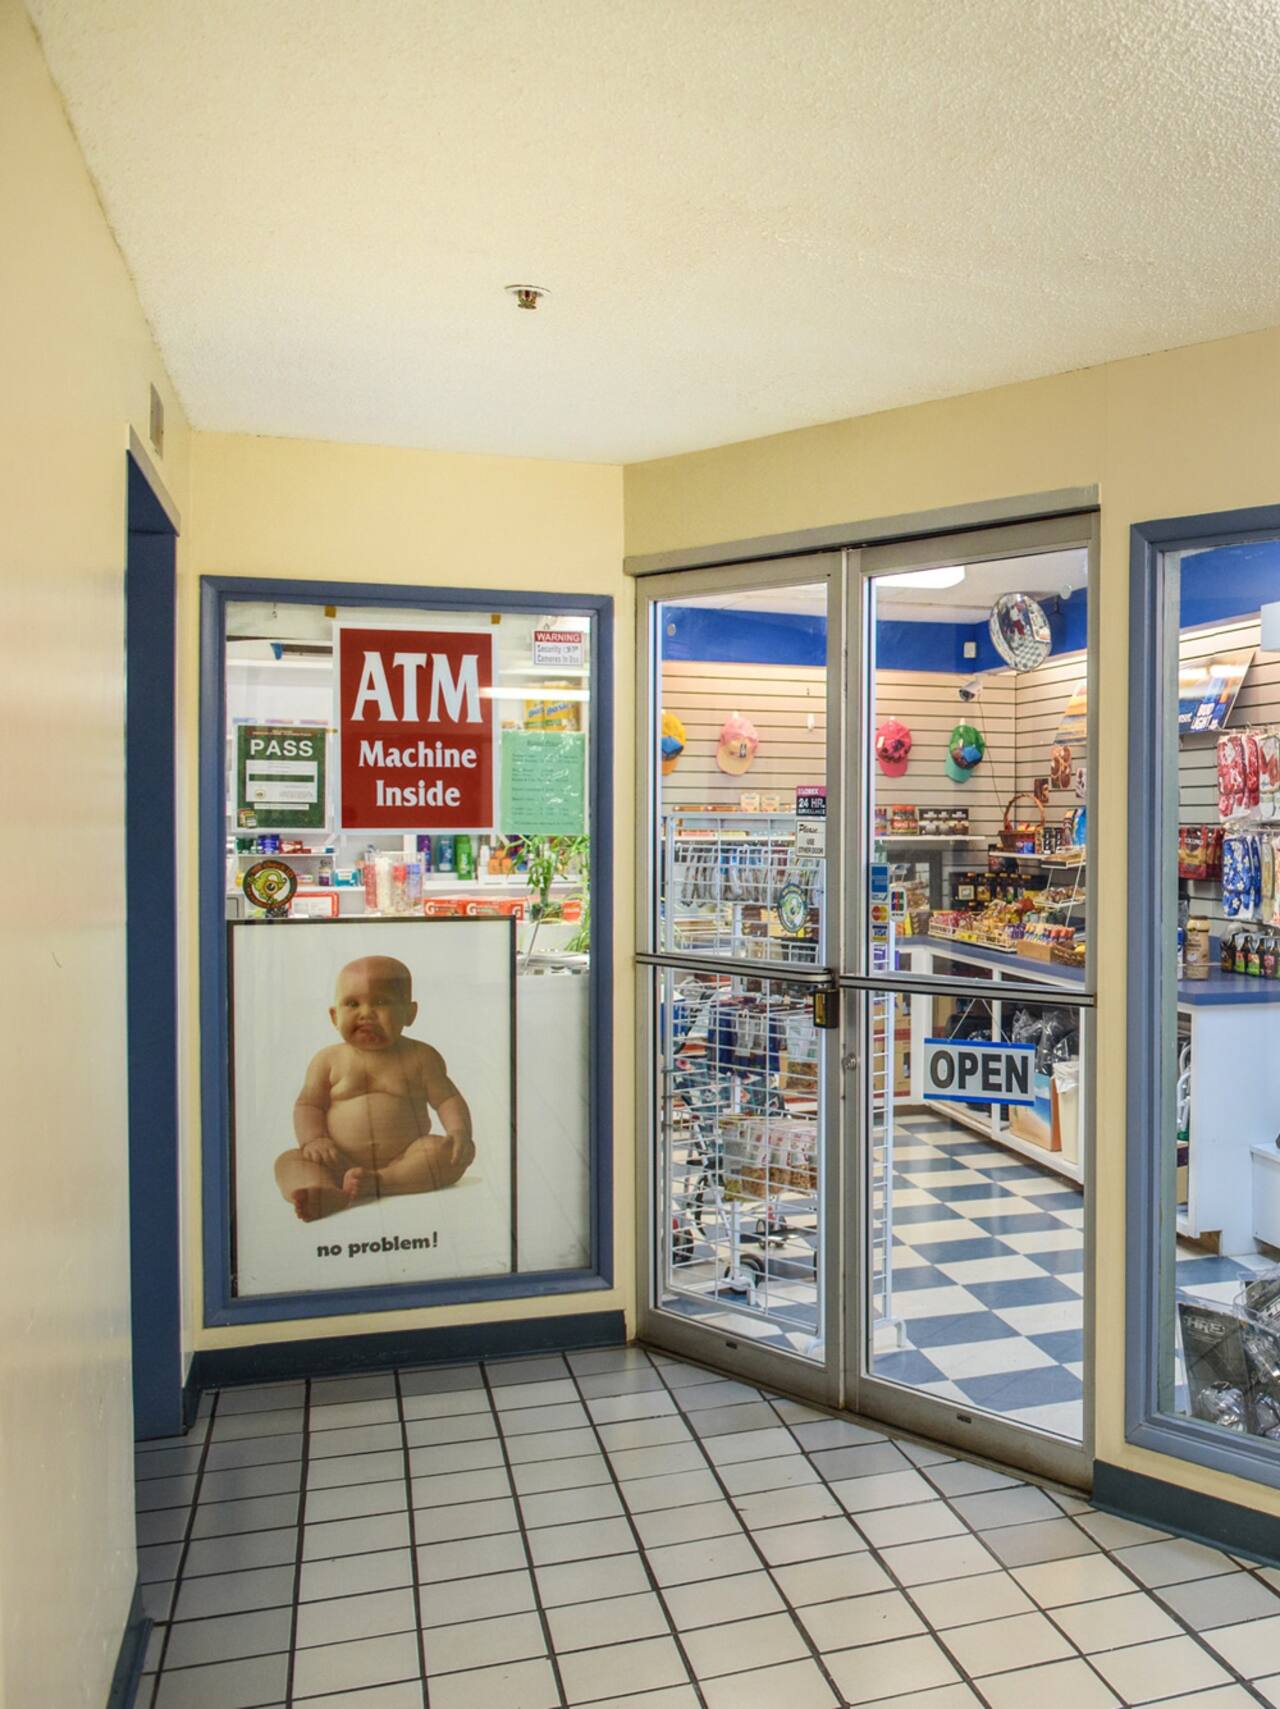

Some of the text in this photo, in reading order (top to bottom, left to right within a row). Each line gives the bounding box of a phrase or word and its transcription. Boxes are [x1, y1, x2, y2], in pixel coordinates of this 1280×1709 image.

[536, 632, 580, 642] WARNING
[350, 651, 483, 723] ATM
[250, 739, 313, 757] PASS
[358, 740, 477, 768] Machine
[376, 779, 461, 807] Inside
[799, 798, 810, 808] 24
[930, 1050, 1029, 1094] OPEN
[317, 1231, 438, 1258] no problem!
